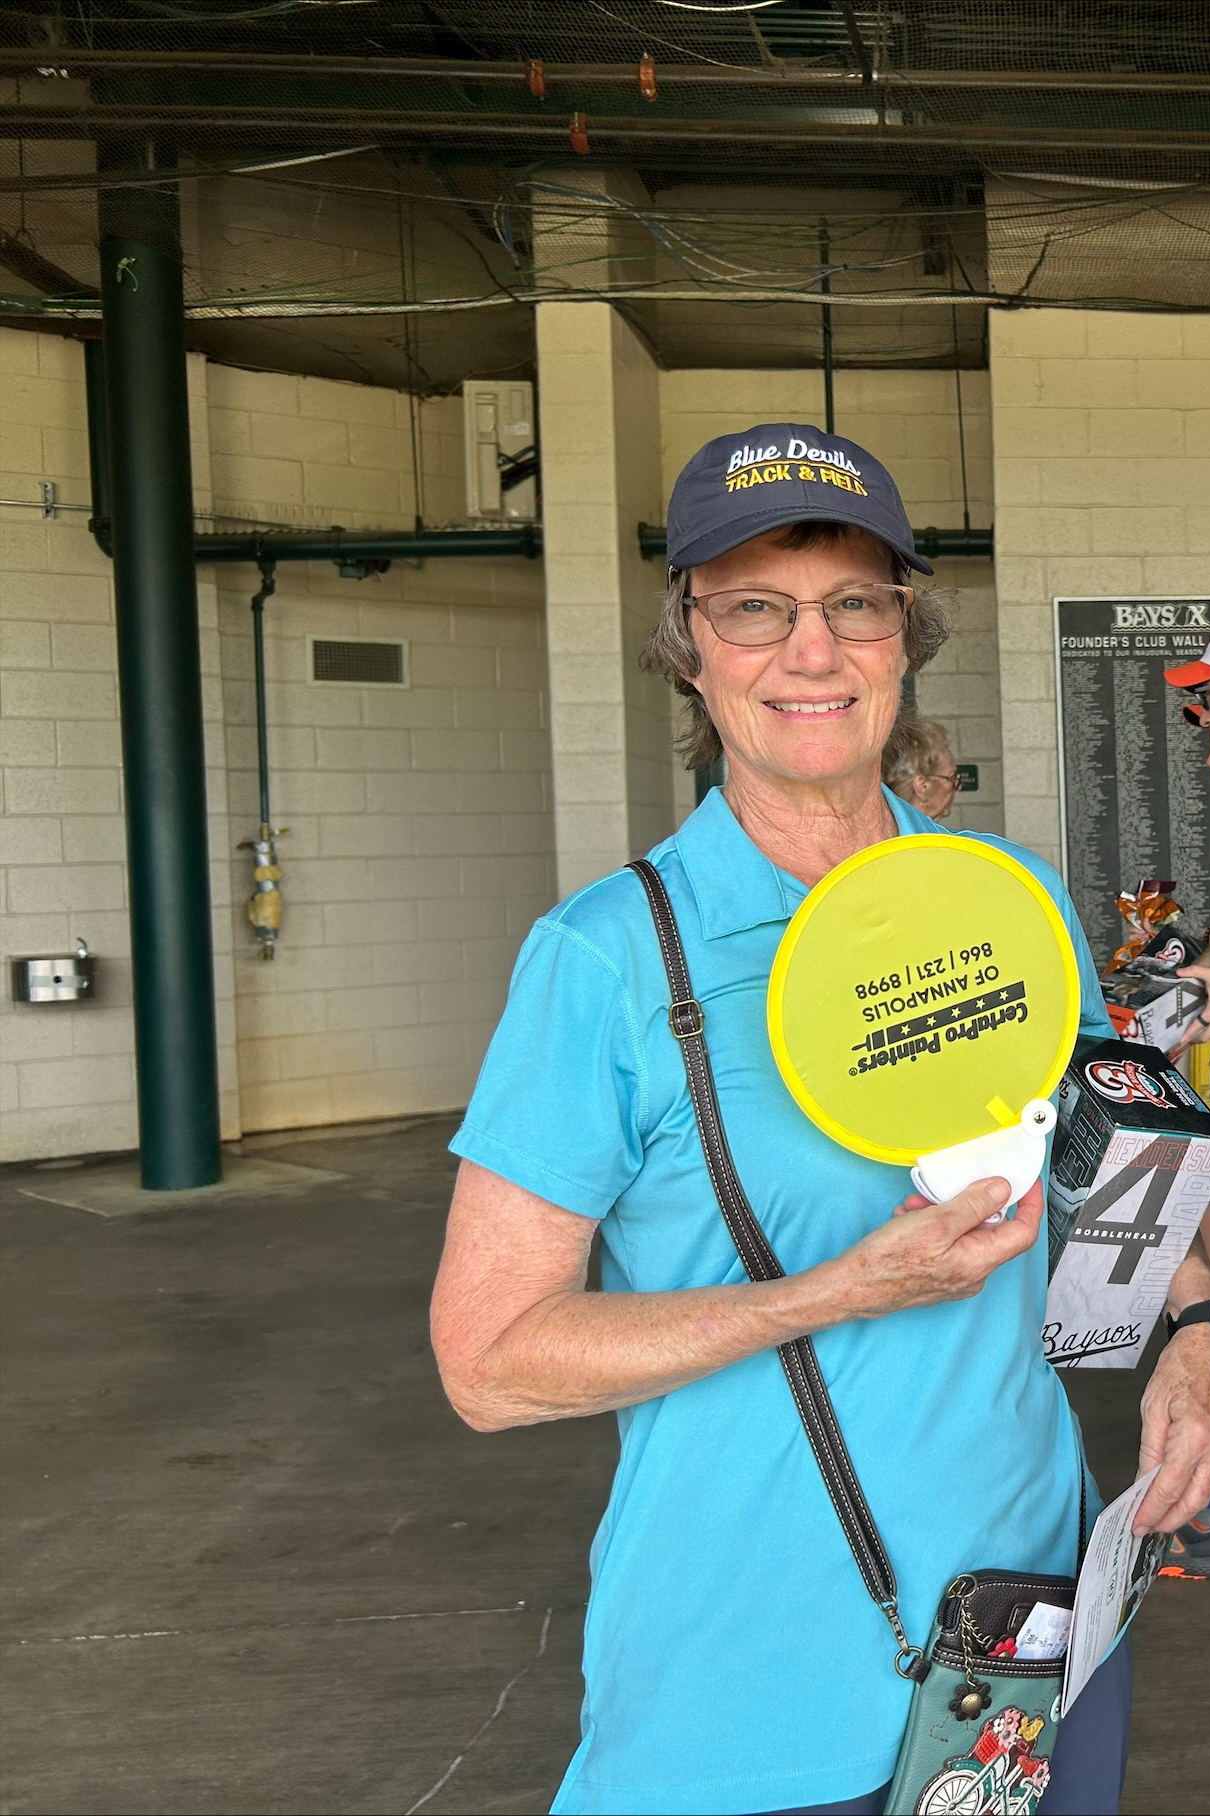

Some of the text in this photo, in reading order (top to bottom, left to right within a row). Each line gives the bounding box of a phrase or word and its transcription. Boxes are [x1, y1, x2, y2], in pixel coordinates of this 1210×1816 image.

[726, 438, 862, 477] Blue Devils
[725, 464, 868, 497] TRACK & FIELD
[1062, 635, 1205, 649] FOUNDER'S CLUB WALL
[1062, 650, 1101, 658] DEDICATED
[960, 942, 993, 966] 866
[917, 958, 946, 981] 231
[855, 973, 901, 1000] 8998
[862, 965, 999, 1023] OF ANNAPOLIS
[945, 1001, 1028, 1042] CertaPro
[1067, 1135, 1192, 1285] 4
[1075, 1228, 1156, 1241] BOBBLEHEAD
[1041, 1321, 1142, 1368] Baysox
